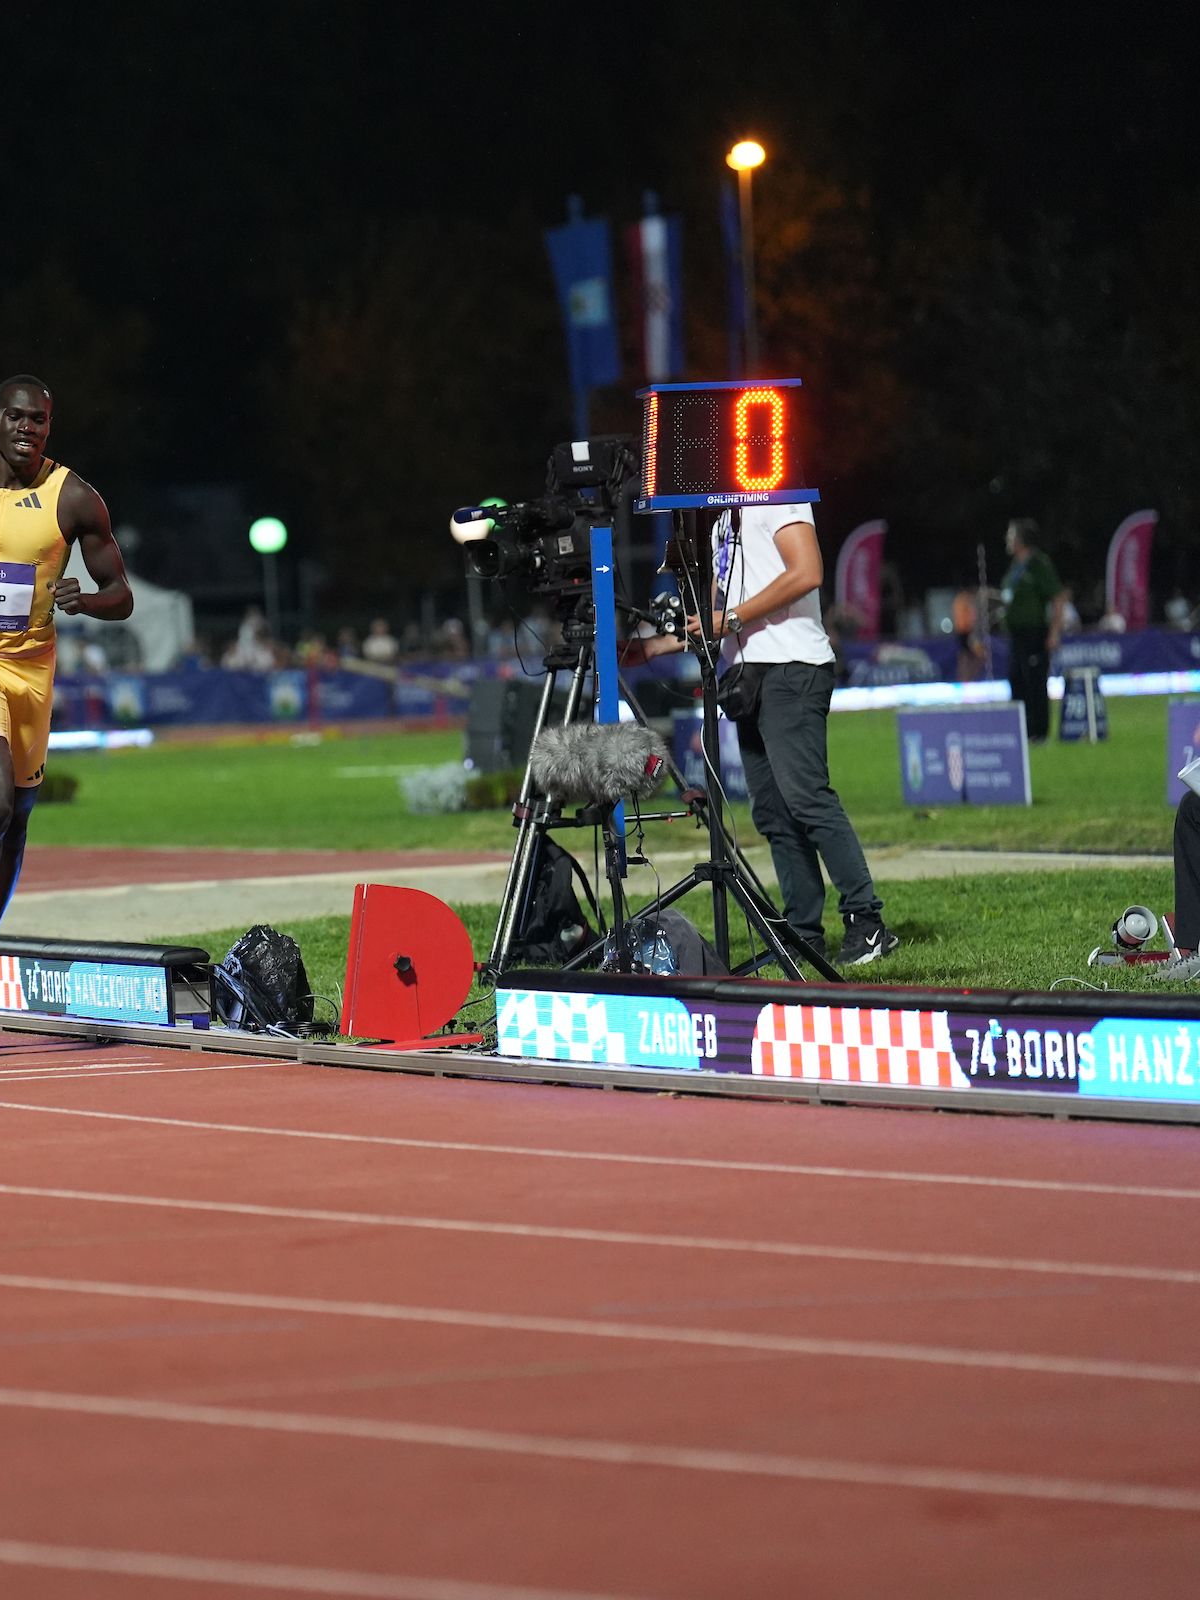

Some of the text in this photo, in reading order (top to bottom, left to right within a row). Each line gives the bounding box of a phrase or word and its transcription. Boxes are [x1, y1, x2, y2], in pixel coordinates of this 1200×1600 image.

[735, 389, 785, 492] 0
[707, 493, 769, 505] ONLINETIMING
[40, 969, 71, 1005] BORIS
[637, 1011, 718, 1058] ZAGREB
[1006, 1029, 1096, 1082] BORIS
[1107, 1025, 1200, 1086] HANŽ
